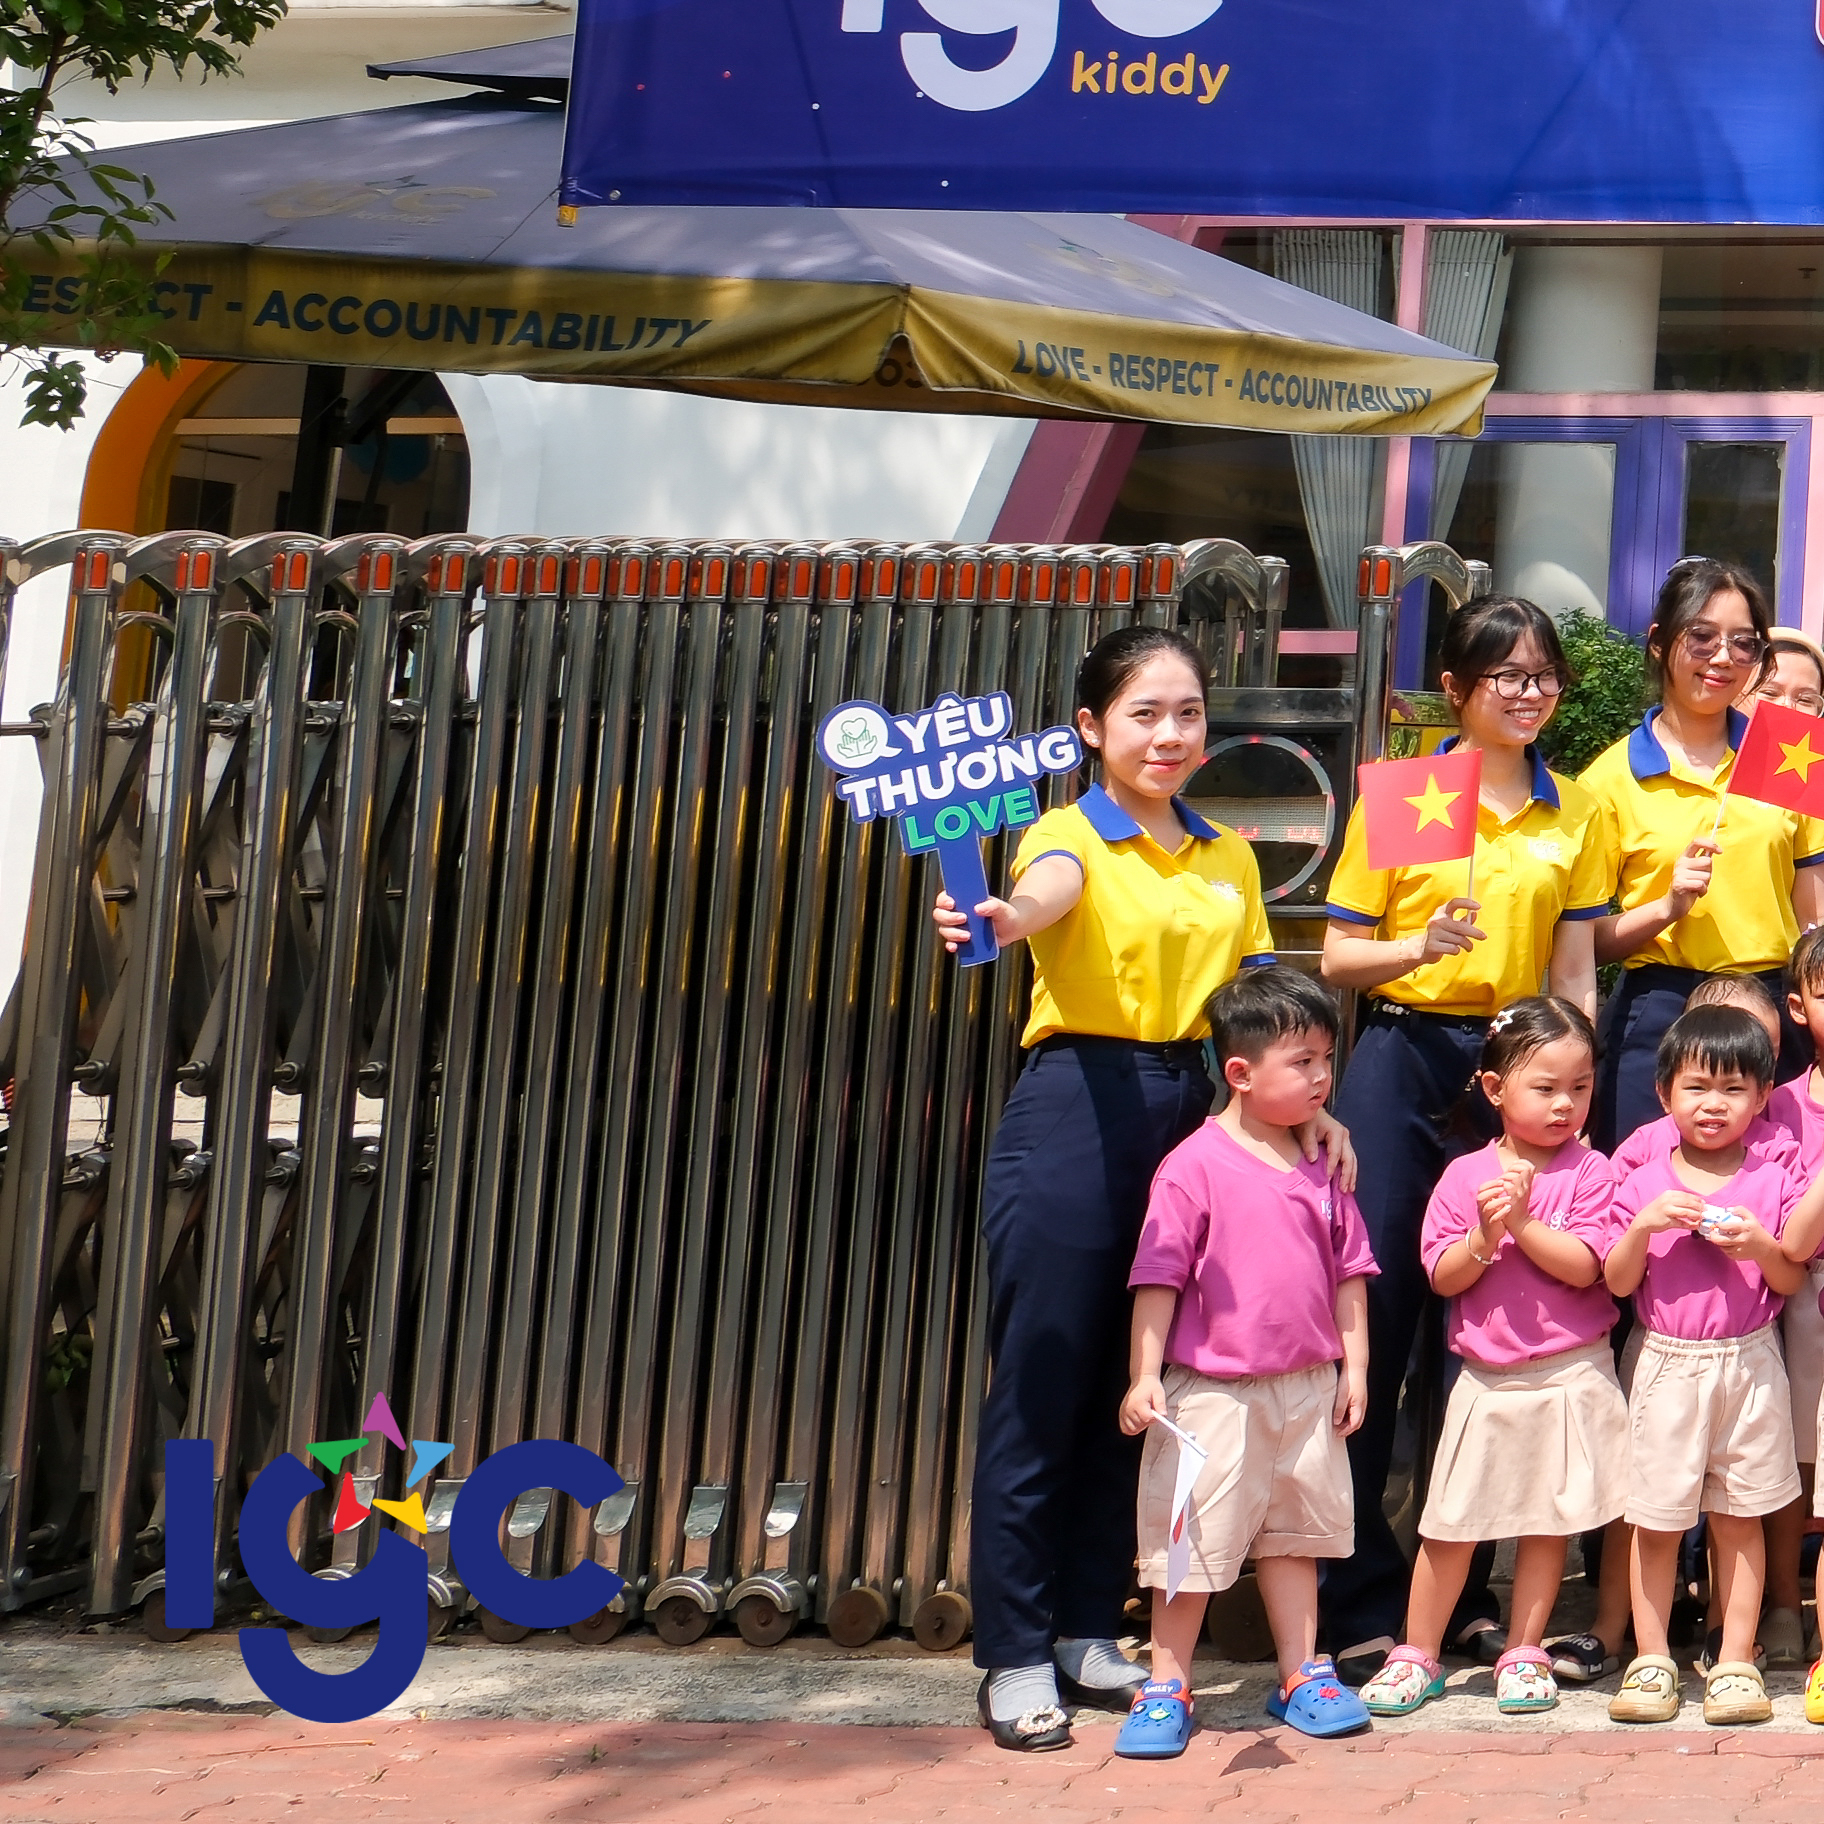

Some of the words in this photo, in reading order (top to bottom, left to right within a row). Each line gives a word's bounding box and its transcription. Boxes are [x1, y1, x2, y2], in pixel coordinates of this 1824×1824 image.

[1070, 48, 1231, 105] kiddy
[253, 288, 712, 353] ACCOUNTABILITY
[1011, 339, 1089, 381] LOVE
[1108, 352, 1219, 397] RESPECT
[1239, 368, 1433, 415] ACCOUNTABILITY
[895, 697, 1005, 754] YÊU
[842, 731, 1076, 817] THƯƠNG
[904, 787, 1035, 850] LOVE
